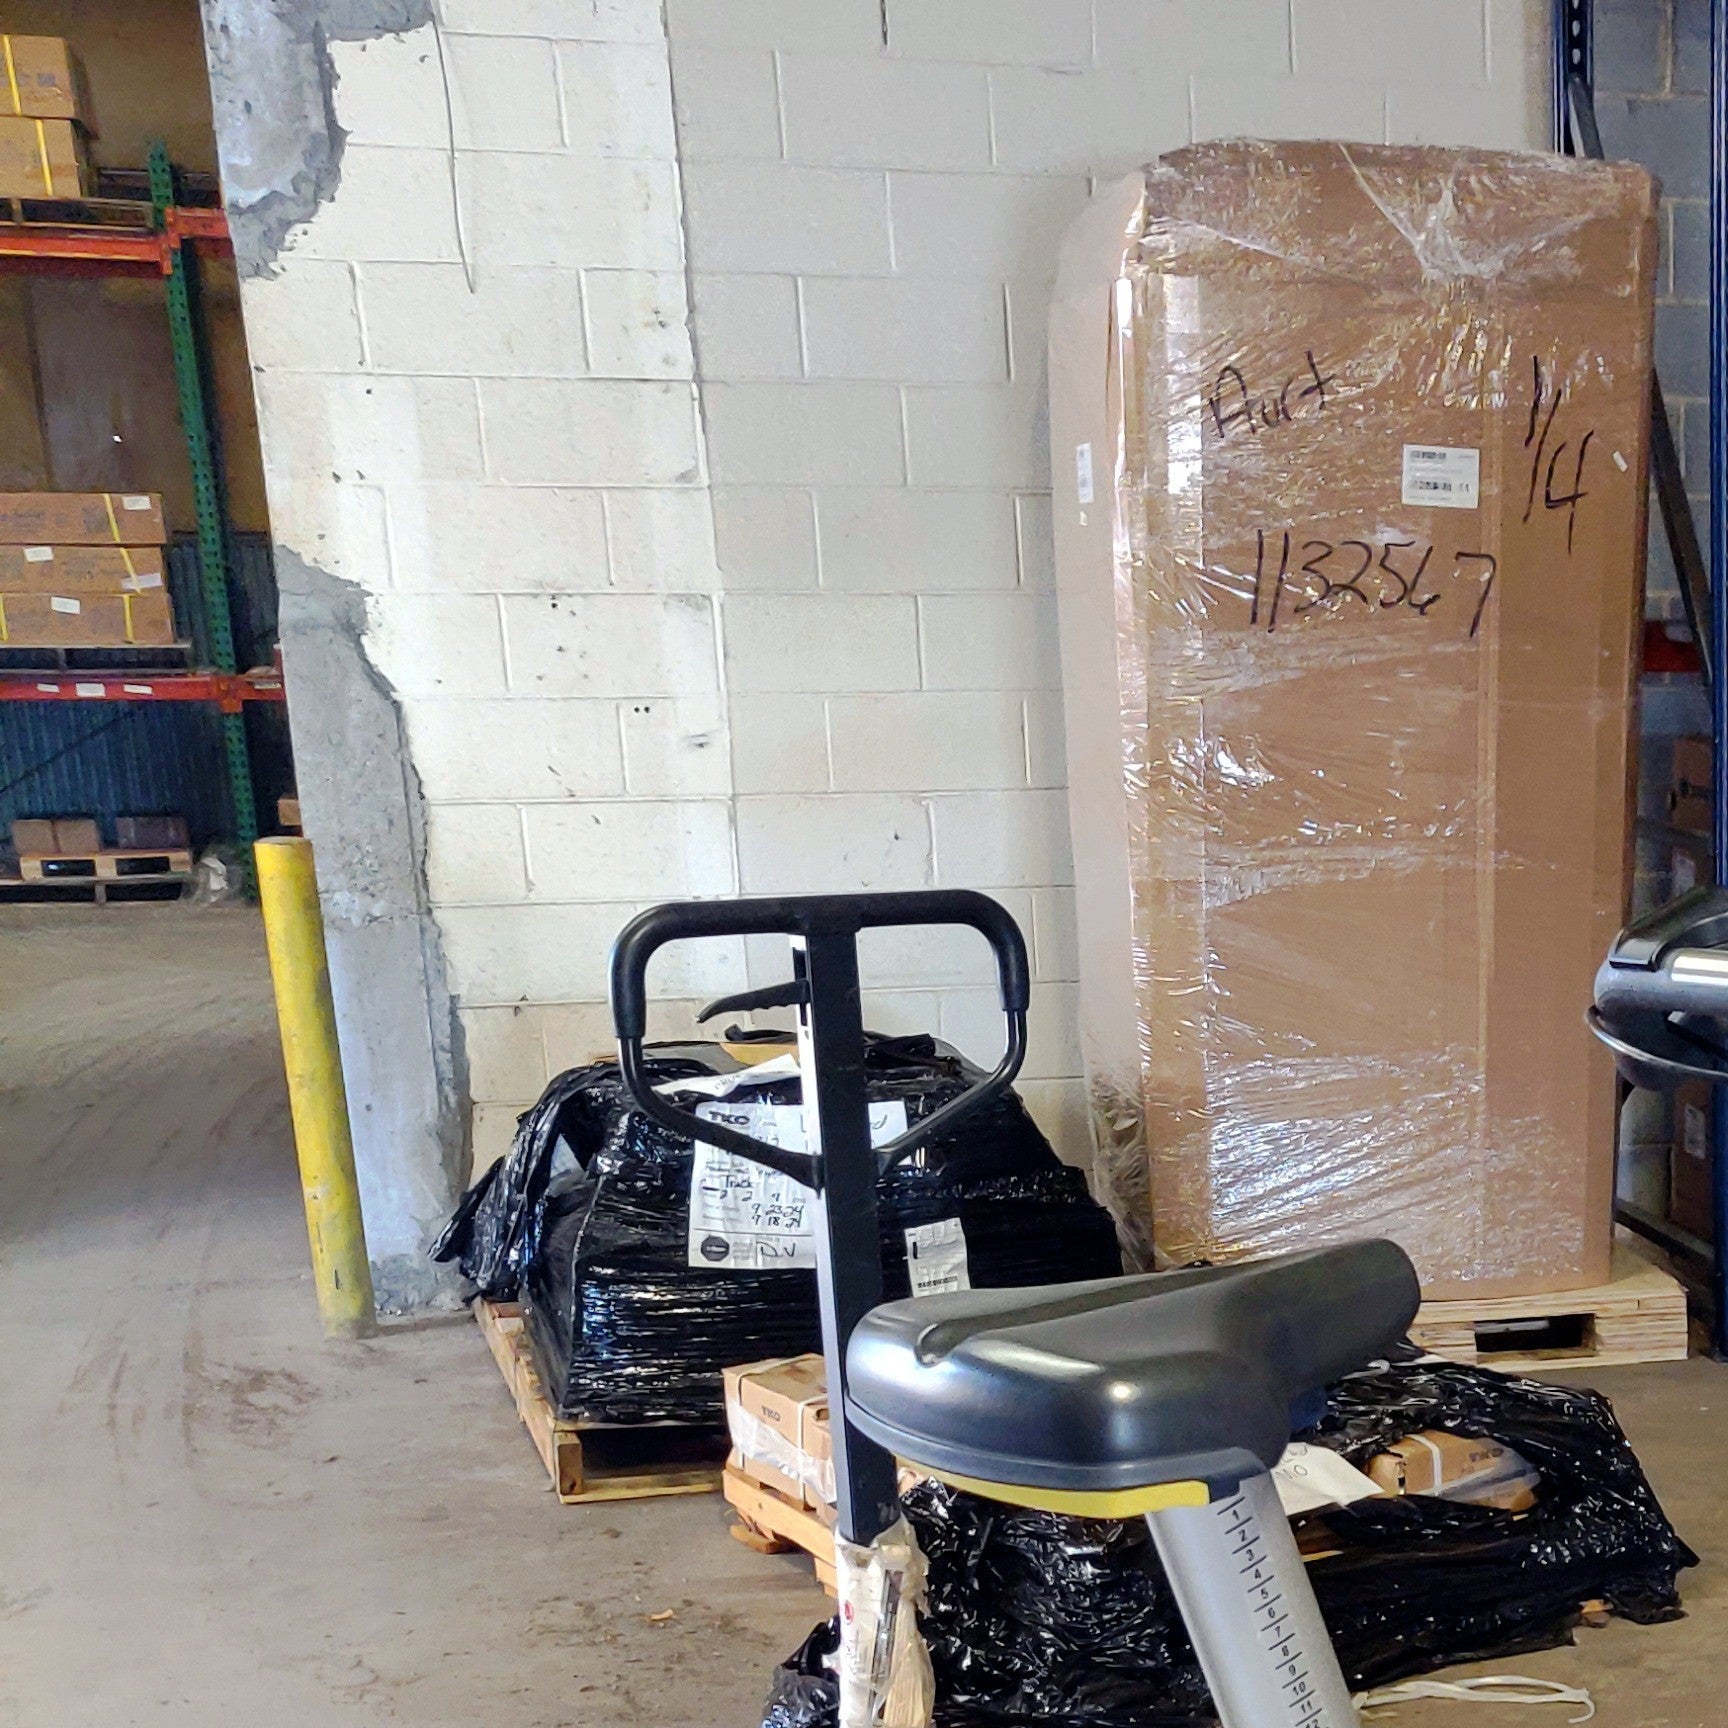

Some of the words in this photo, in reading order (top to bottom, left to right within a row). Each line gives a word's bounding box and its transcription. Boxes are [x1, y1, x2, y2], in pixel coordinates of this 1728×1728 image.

[1251, 529, 1497, 638] 1132567
[709, 1110, 750, 1126] TKO
[1292, 1682, 1306, 1695] 10
[1301, 1701, 1312, 1713] 11
